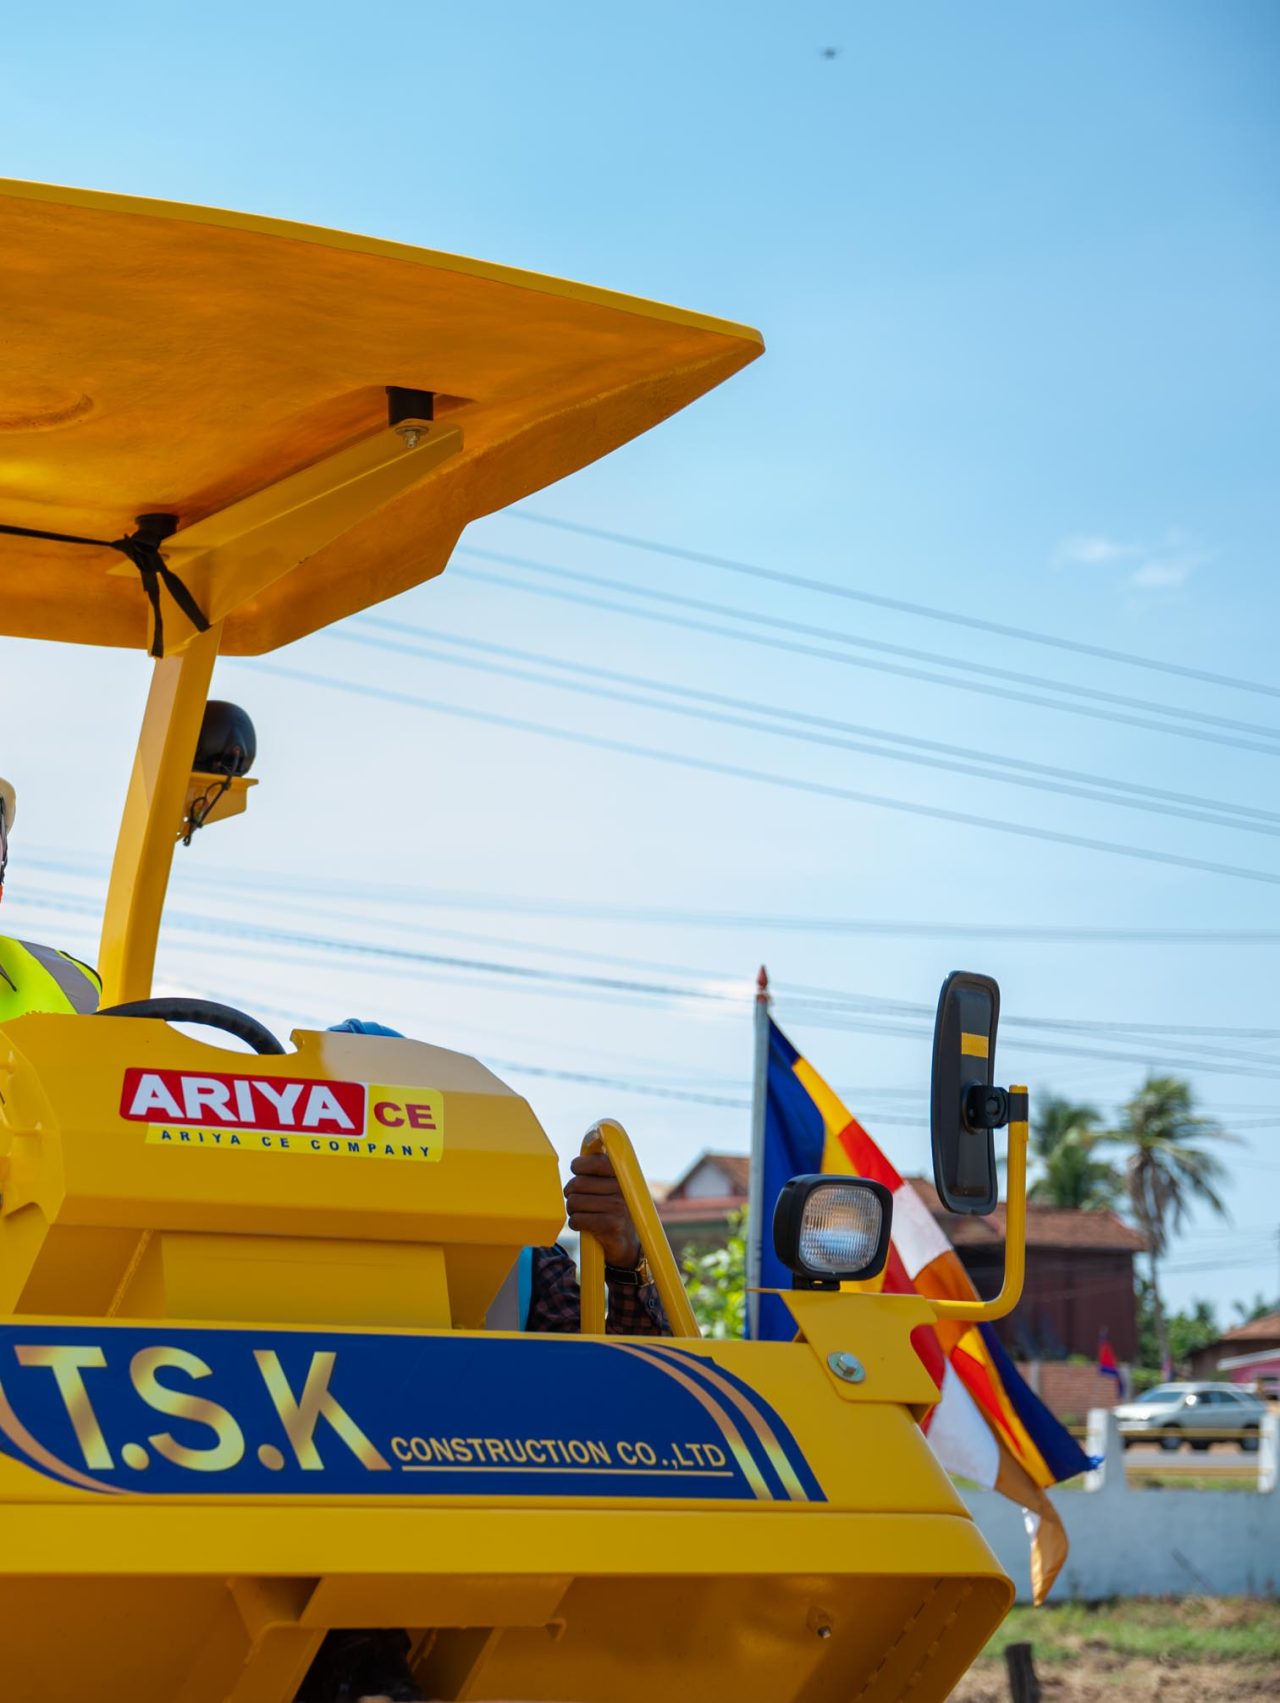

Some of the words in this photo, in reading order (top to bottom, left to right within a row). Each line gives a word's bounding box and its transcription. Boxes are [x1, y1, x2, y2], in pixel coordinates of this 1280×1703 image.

[128, 1073, 356, 1130] ARIYA
[373, 1101, 437, 1130] CE
[160, 1129, 241, 1146] ARIYA
[261, 1135, 290, 1148] CE
[310, 1139, 429, 1158] COMPANY
[13, 1345, 393, 1472] T.S.K
[391, 1436, 612, 1466] CONSTRUCTION
